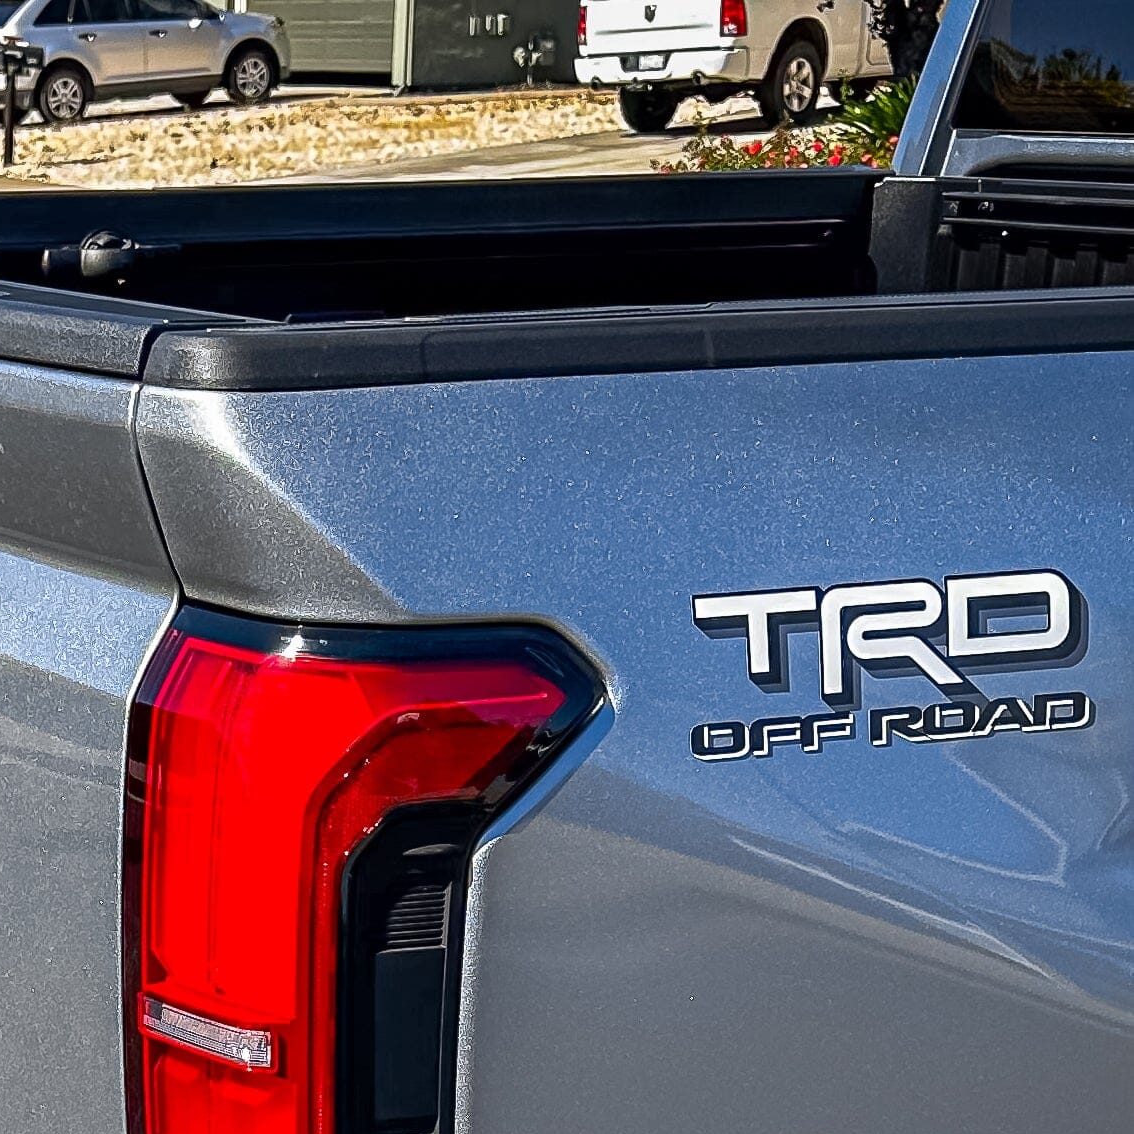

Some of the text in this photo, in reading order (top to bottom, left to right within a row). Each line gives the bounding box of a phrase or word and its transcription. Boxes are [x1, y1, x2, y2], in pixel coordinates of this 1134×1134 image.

[692, 568, 1088, 711] TRD
[690, 691, 1096, 761] OFF ROAD
